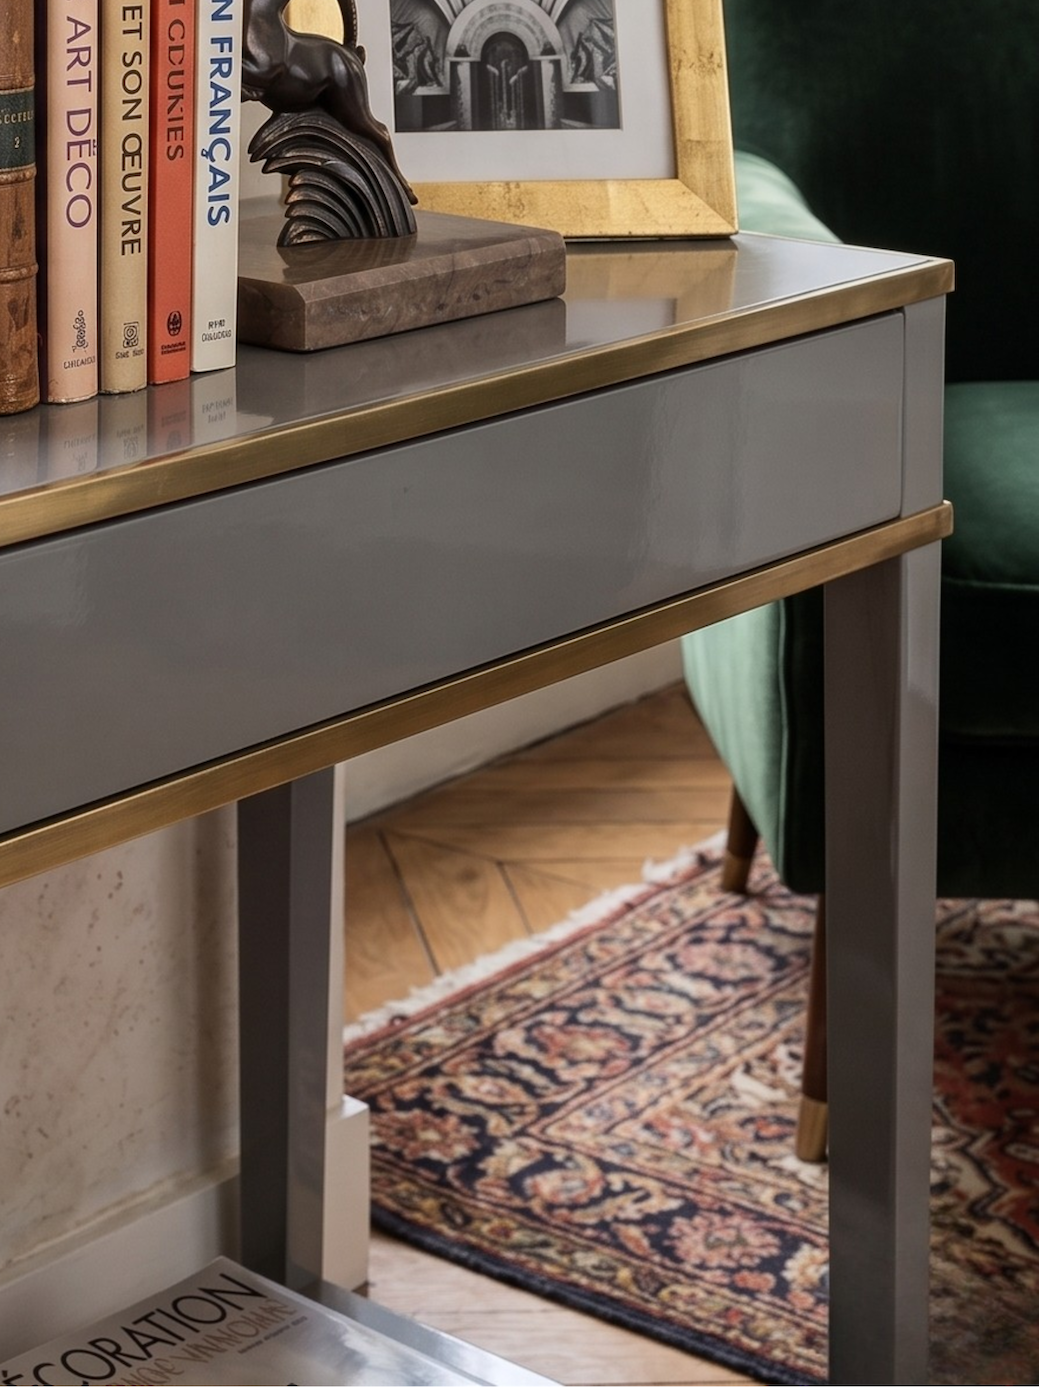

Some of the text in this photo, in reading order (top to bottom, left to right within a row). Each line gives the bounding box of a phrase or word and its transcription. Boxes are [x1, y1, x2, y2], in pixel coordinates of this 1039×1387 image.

[66, 15, 92, 92] ART
[122, 5, 143, 40] ET
[121, 51, 142, 121] SON
[201, 36, 233, 226] FRANÇAIS
[121, 133, 142, 256] ŒUVRE
